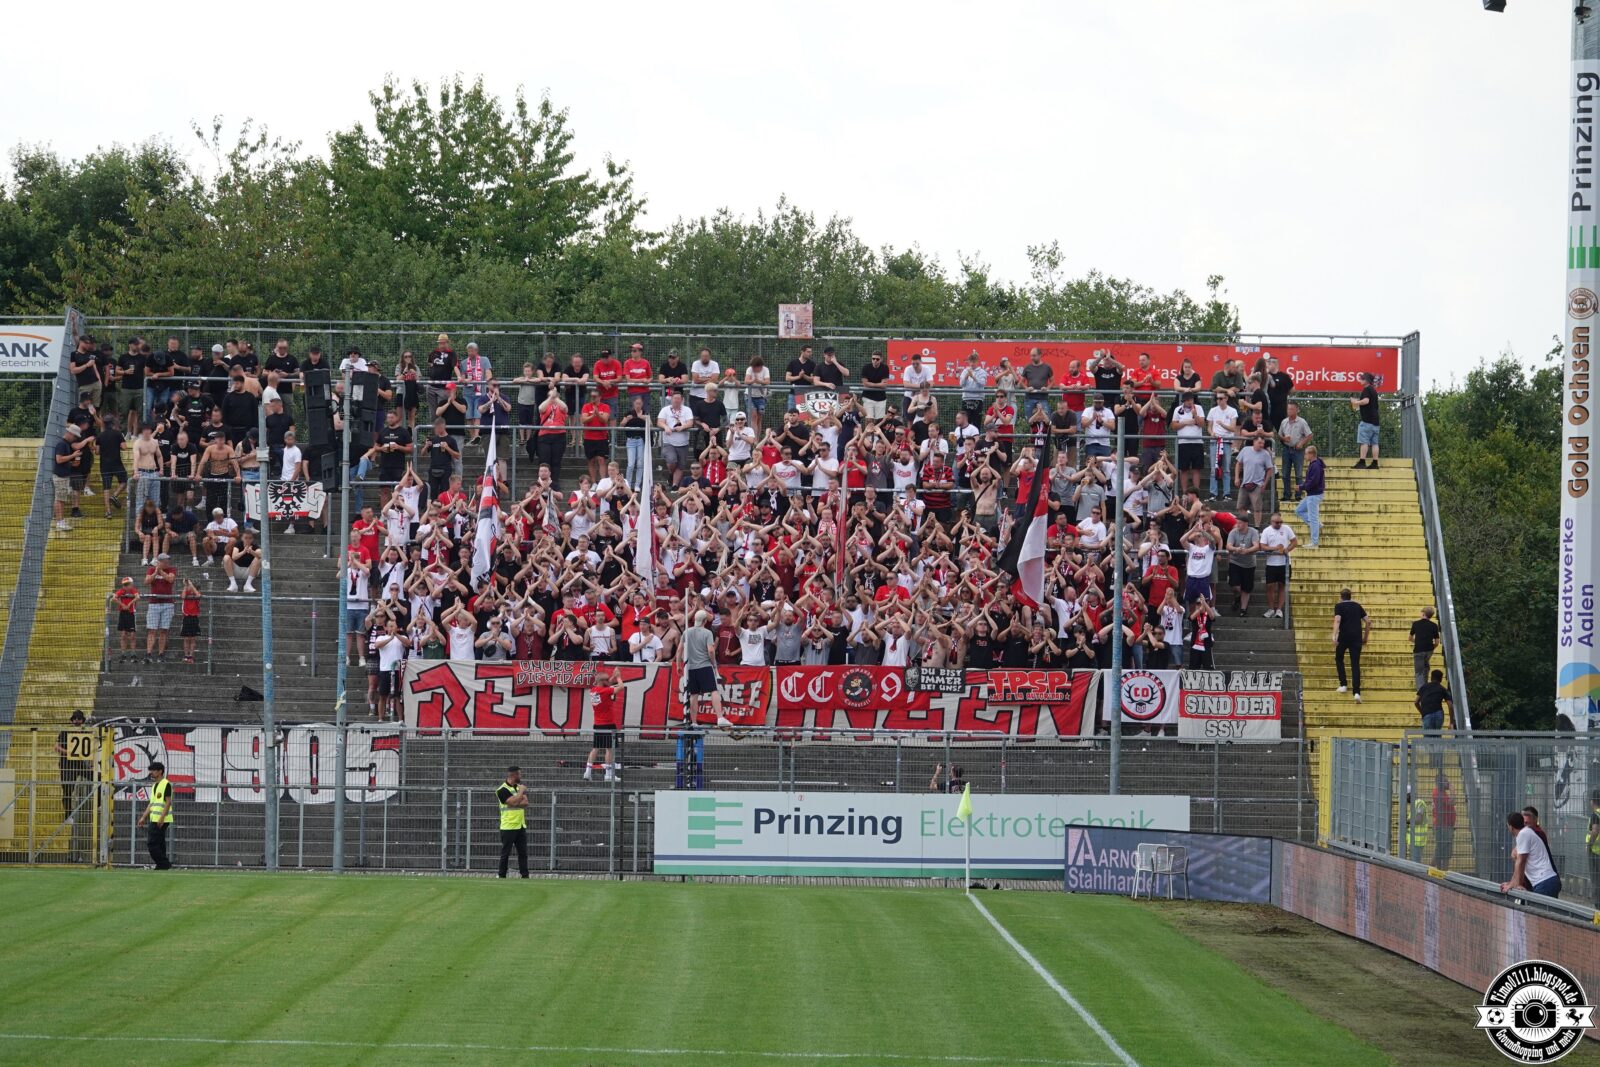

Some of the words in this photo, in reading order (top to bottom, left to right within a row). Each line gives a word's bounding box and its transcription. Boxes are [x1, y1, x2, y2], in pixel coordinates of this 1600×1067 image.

[1571, 72, 1600, 212] Prinzing
[1567, 326, 1590, 426] Ochsen
[1567, 436, 1590, 499] Gold
[1560, 517, 1574, 648] Stadtwerke
[1577, 583, 1594, 648] Aalen
[921, 675, 962, 685] IMMER
[939, 669, 962, 677] BIST
[1181, 671, 1225, 691] WIR
[1228, 671, 1283, 692] ALLE
[1184, 695, 1232, 715] SIND
[1235, 696, 1276, 716] DER
[70, 736, 92, 758] 20
[1205, 719, 1246, 738] SSV
[185, 722, 402, 805] 1905
[754, 807, 902, 844] Prinzing
